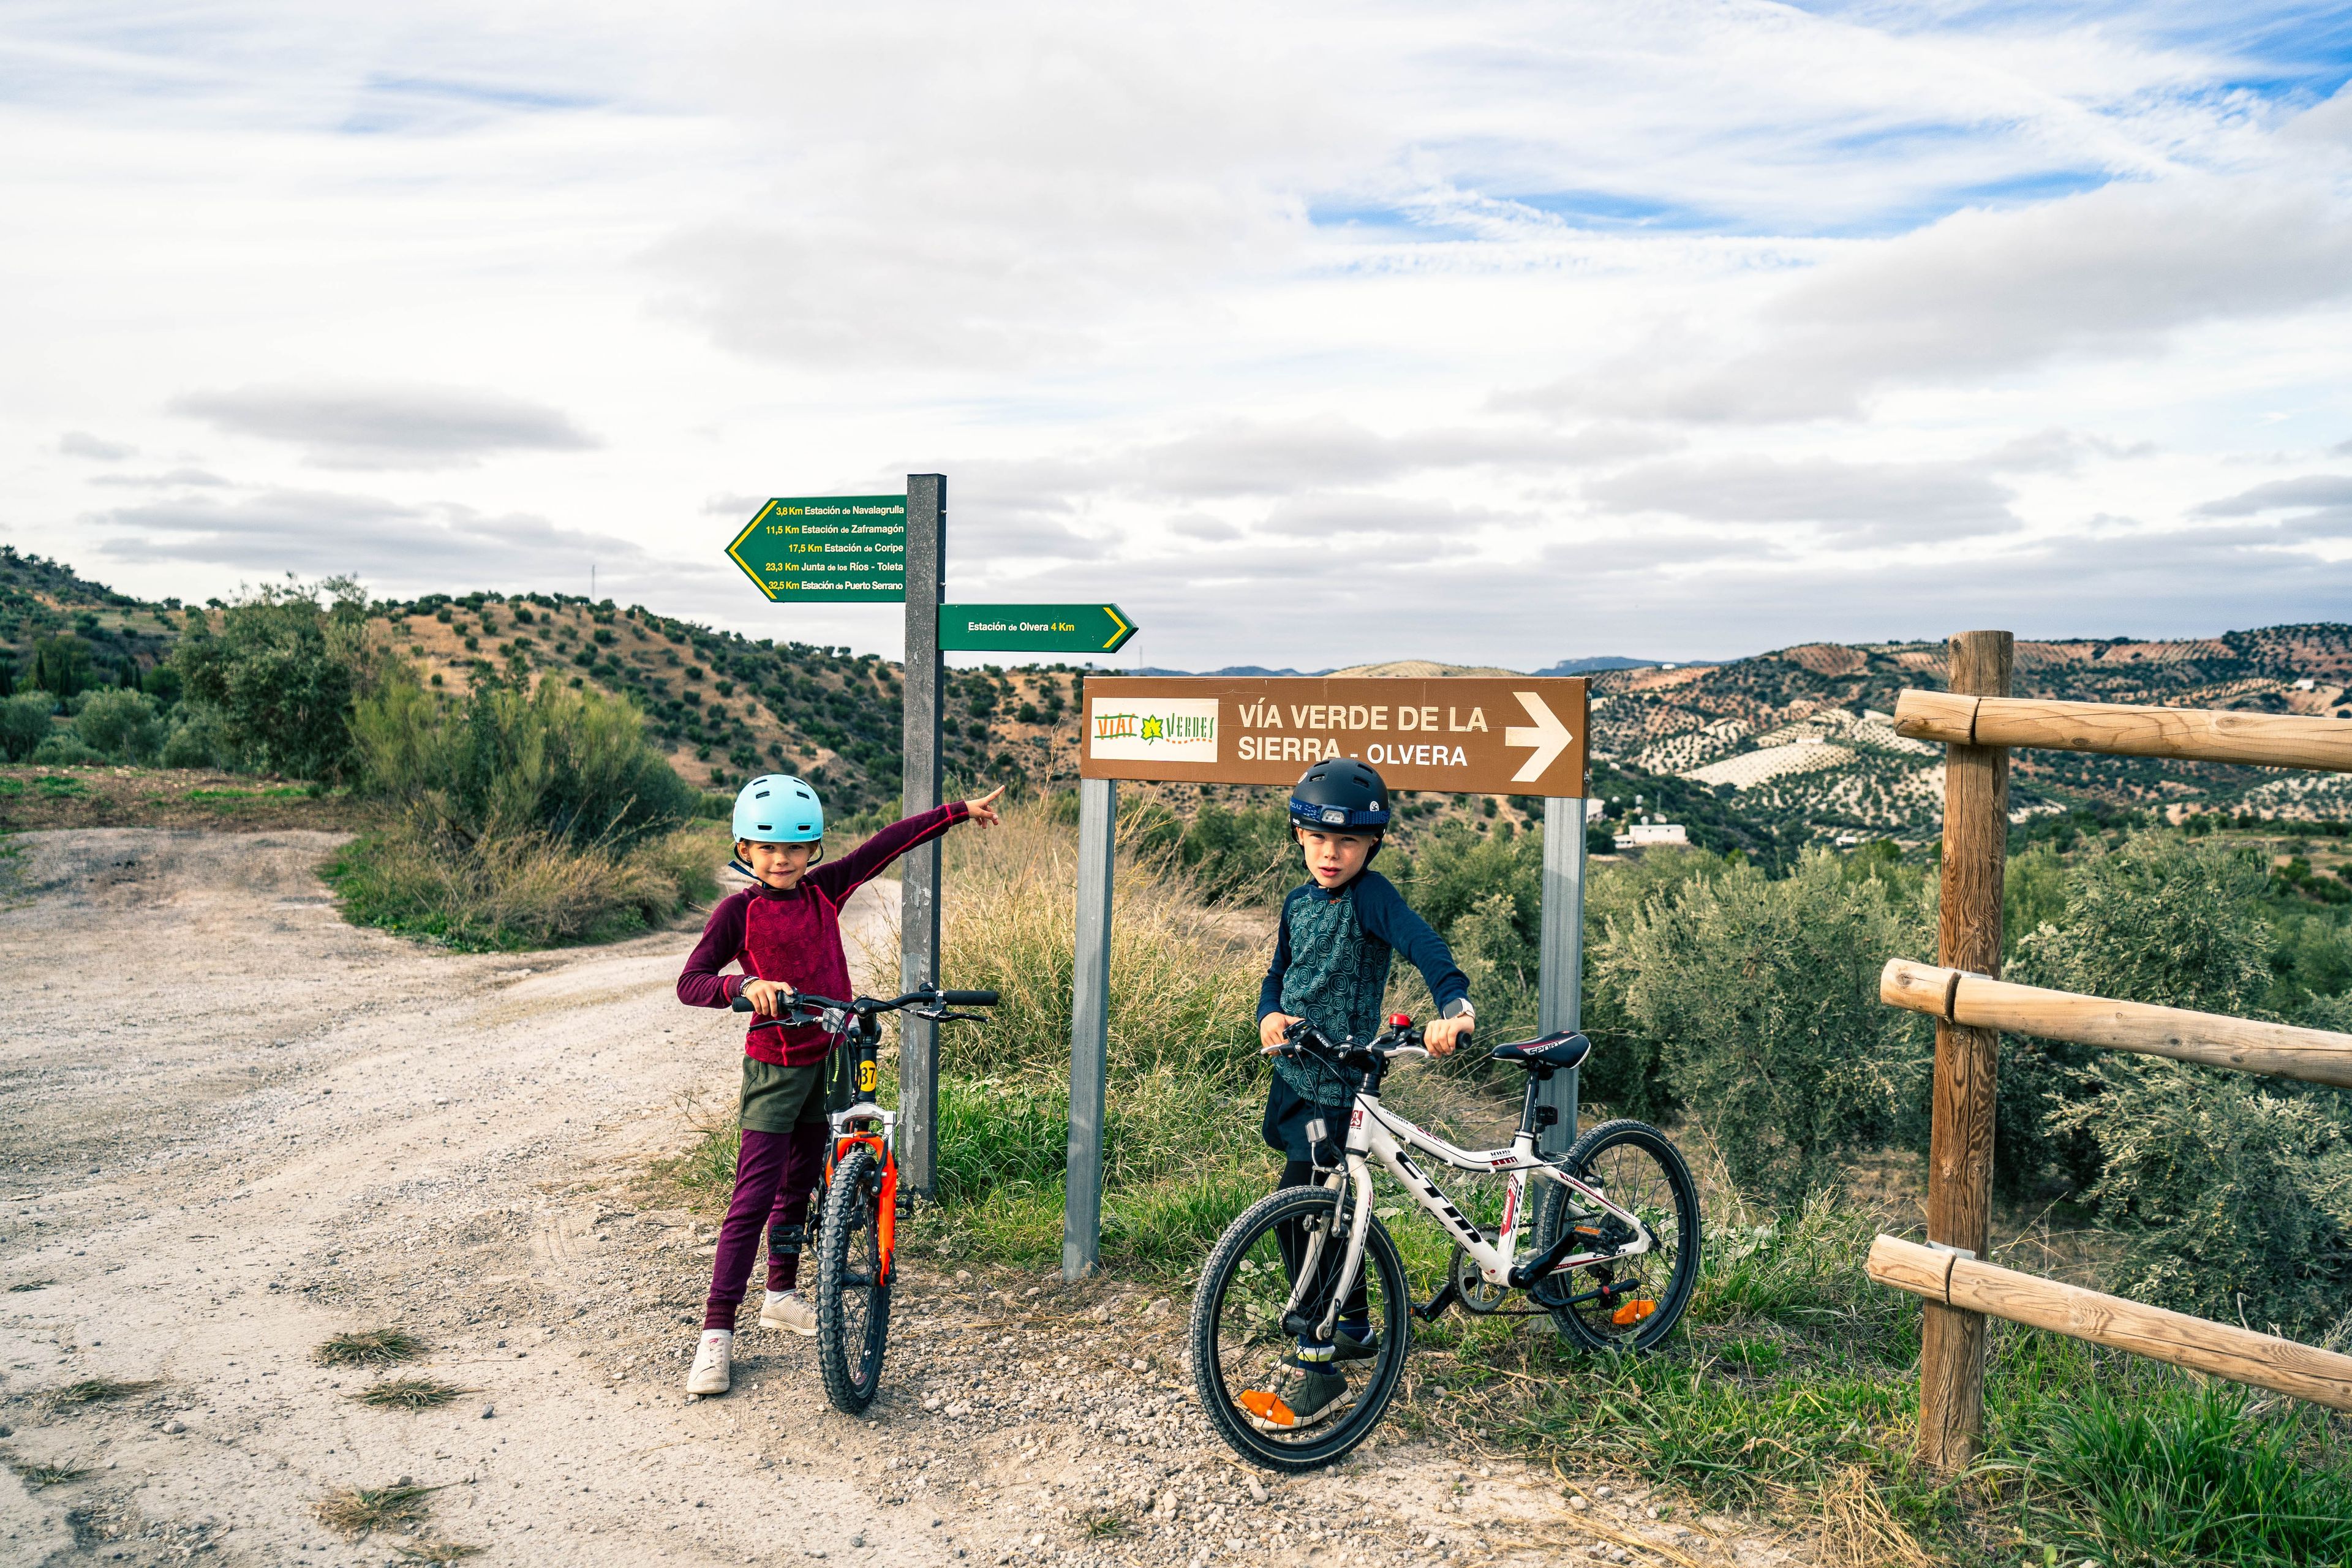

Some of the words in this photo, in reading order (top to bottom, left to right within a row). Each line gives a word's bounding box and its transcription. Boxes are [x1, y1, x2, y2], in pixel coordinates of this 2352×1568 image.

[776, 507, 788, 516] 3,8
[789, 507, 803, 515] Km
[805, 506, 840, 515] Estación
[852, 505, 905, 516] Navalagrulla
[766, 526, 783, 535] 11,5
[785, 525, 799, 534] Km
[801, 524, 839, 534] Estación
[851, 524, 904, 535] Zaframagón
[788, 544, 806, 554] 17,5
[807, 544, 823, 552] Km
[824, 543, 862, 552] Estación
[874, 543, 904, 553] Coripe
[765, 562, 783, 572] 23,3
[785, 562, 799, 571] Km
[801, 562, 826, 571] Junta
[850, 562, 869, 571] Ríos
[876, 562, 903, 571] Toleta
[768, 581, 785, 592] 32,5
[785, 581, 800, 590] Km
[801, 580, 834, 590] Estación
[845, 581, 871, 590] Puerto
[872, 581, 903, 590] Serrano
[968, 621, 1006, 631] Estación
[1019, 622, 1049, 631] Olvera
[1050, 622, 1057, 631] 4
[1058, 622, 1075, 631] Km
[1238, 697, 1283, 728] VÍA
[1291, 704, 1389, 730] VERDE
[1398, 706, 1439, 731] DE
[1449, 707, 1489, 733] LA
[1166, 712, 1215, 739] VERDES
[1238, 736, 1341, 761] SIERRA
[1366, 744, 1468, 766] OLVERA
[1529, 1041, 1560, 1055] SPORT
[1395, 1151, 1482, 1244] CTM
